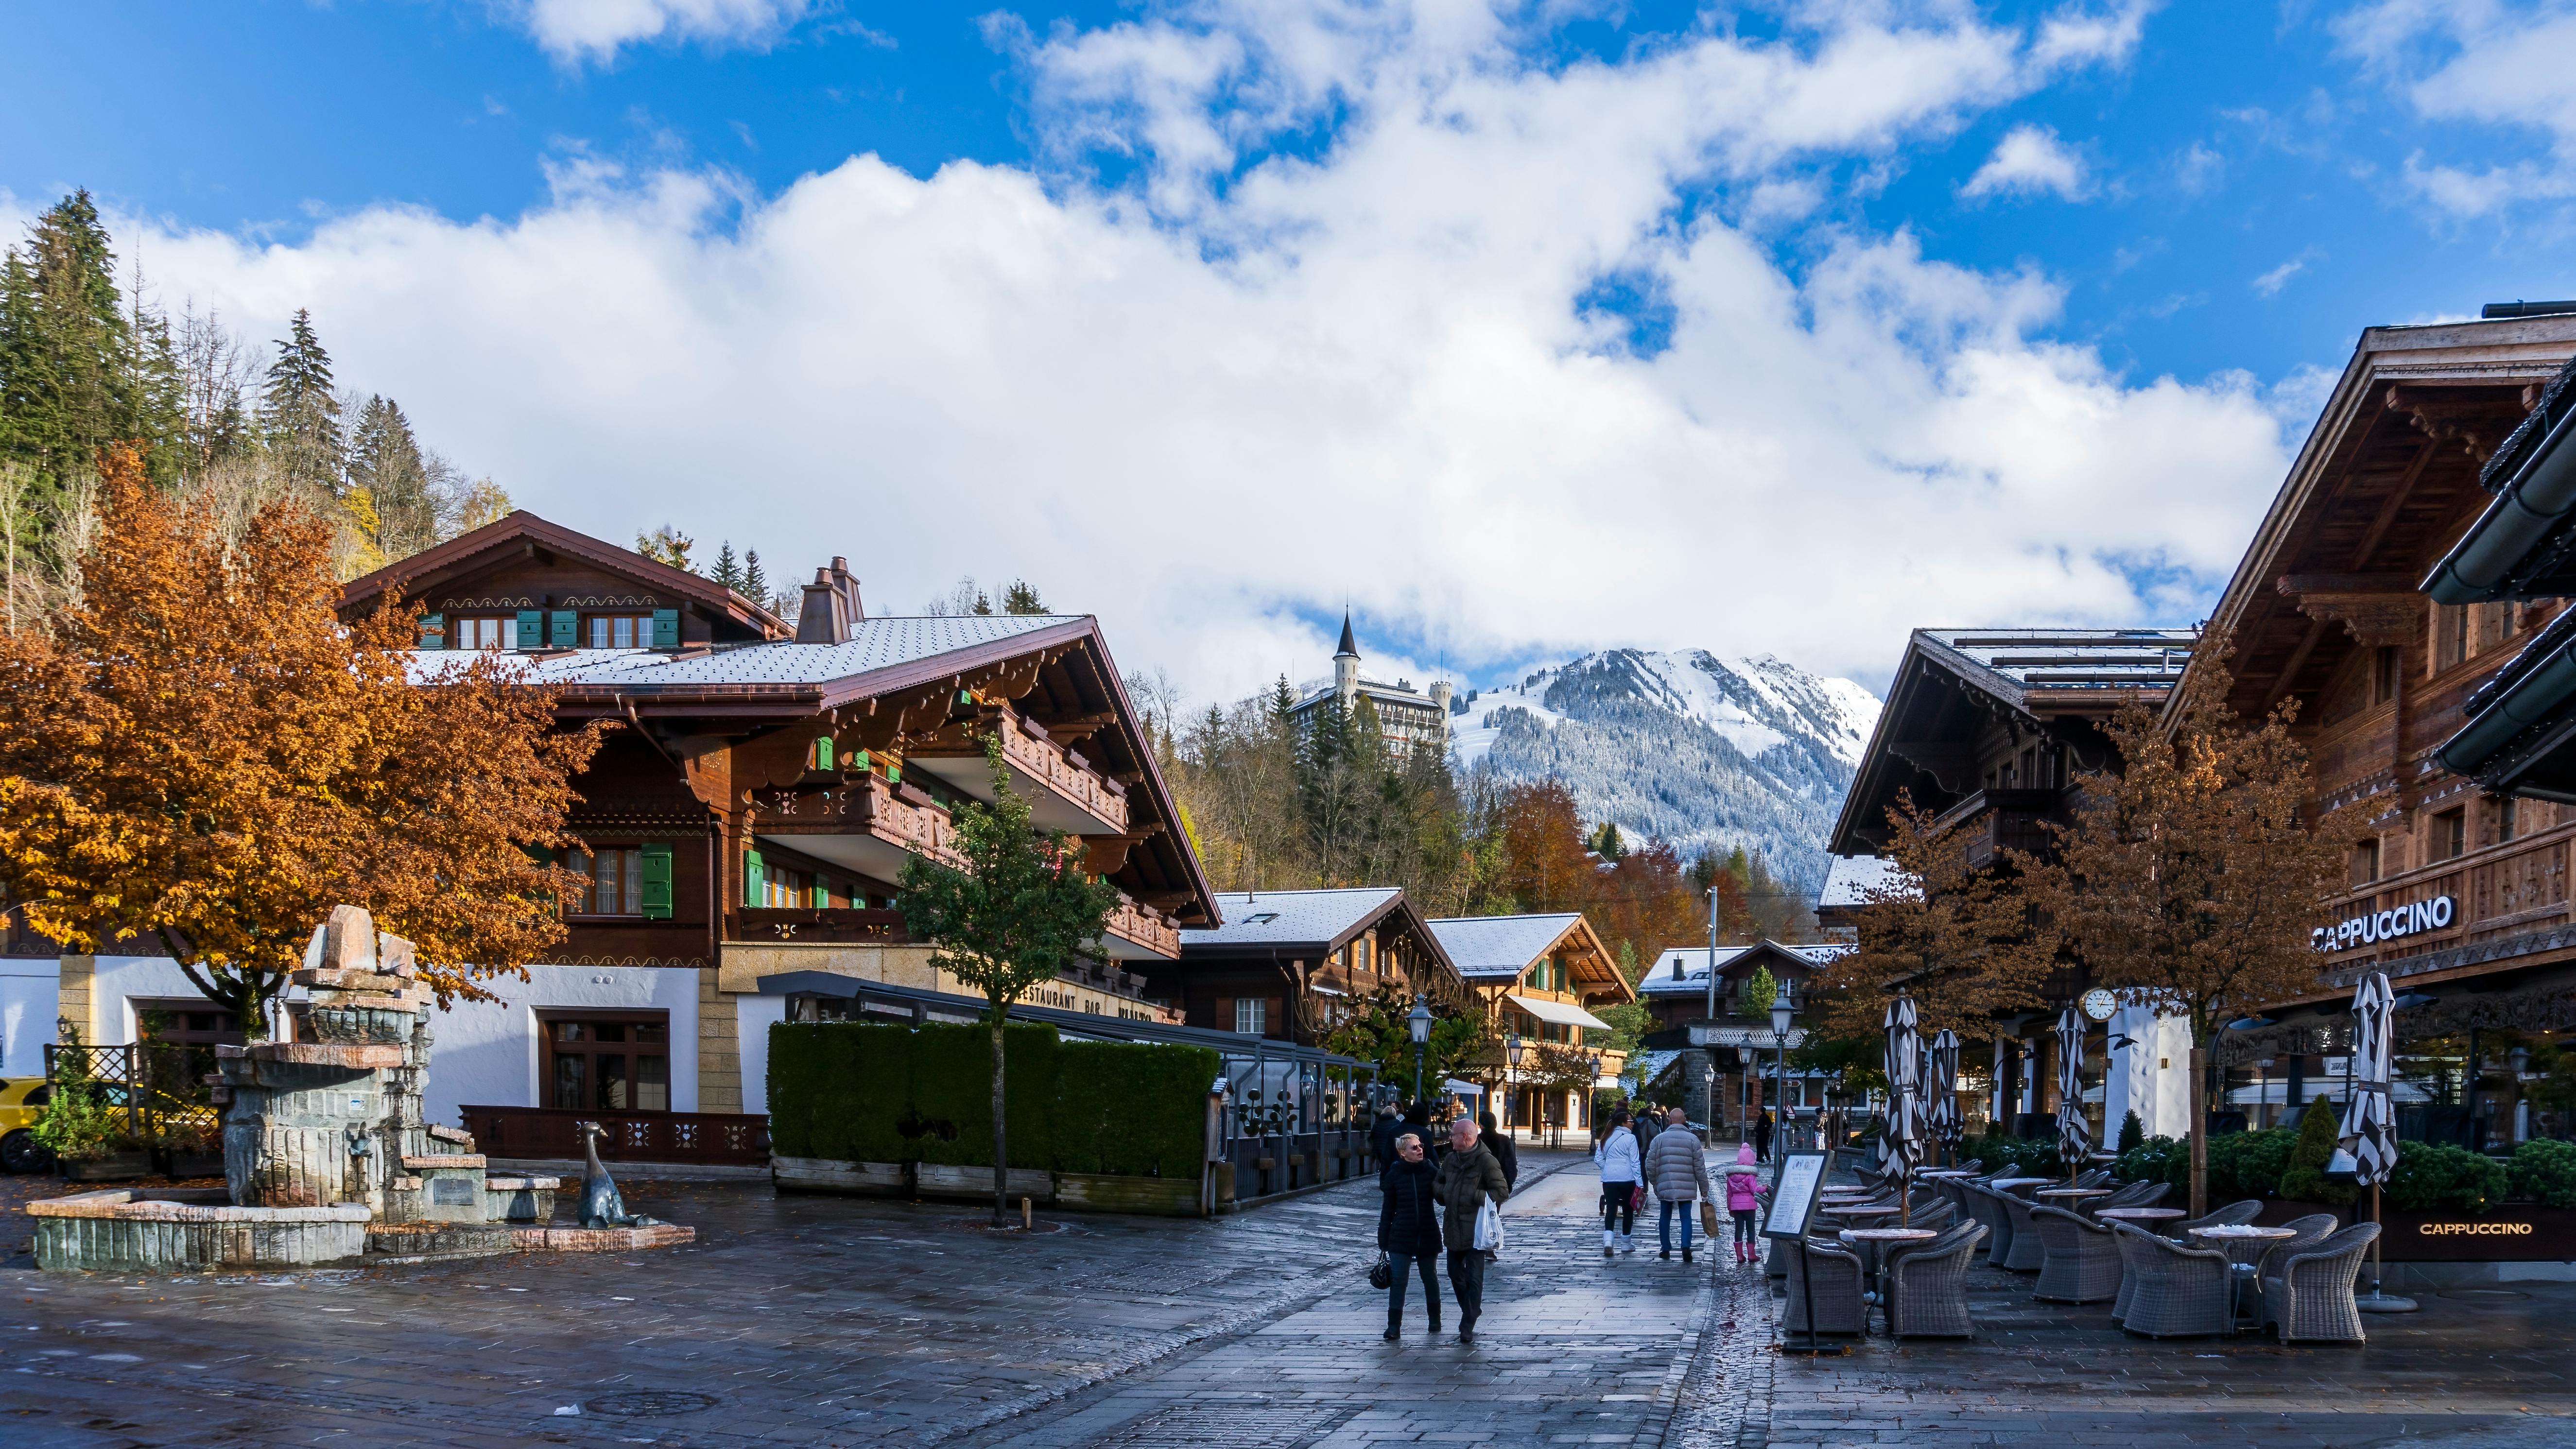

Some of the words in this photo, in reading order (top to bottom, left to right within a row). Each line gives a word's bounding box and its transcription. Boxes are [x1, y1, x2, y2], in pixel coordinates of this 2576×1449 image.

[2311, 896, 2452, 953] CAPPUCCINO
[1018, 986, 1075, 1010] ESTAURANT
[1085, 1000, 1100, 1015] BAR
[2420, 1224, 2532, 1235] CAPPUCCINO
